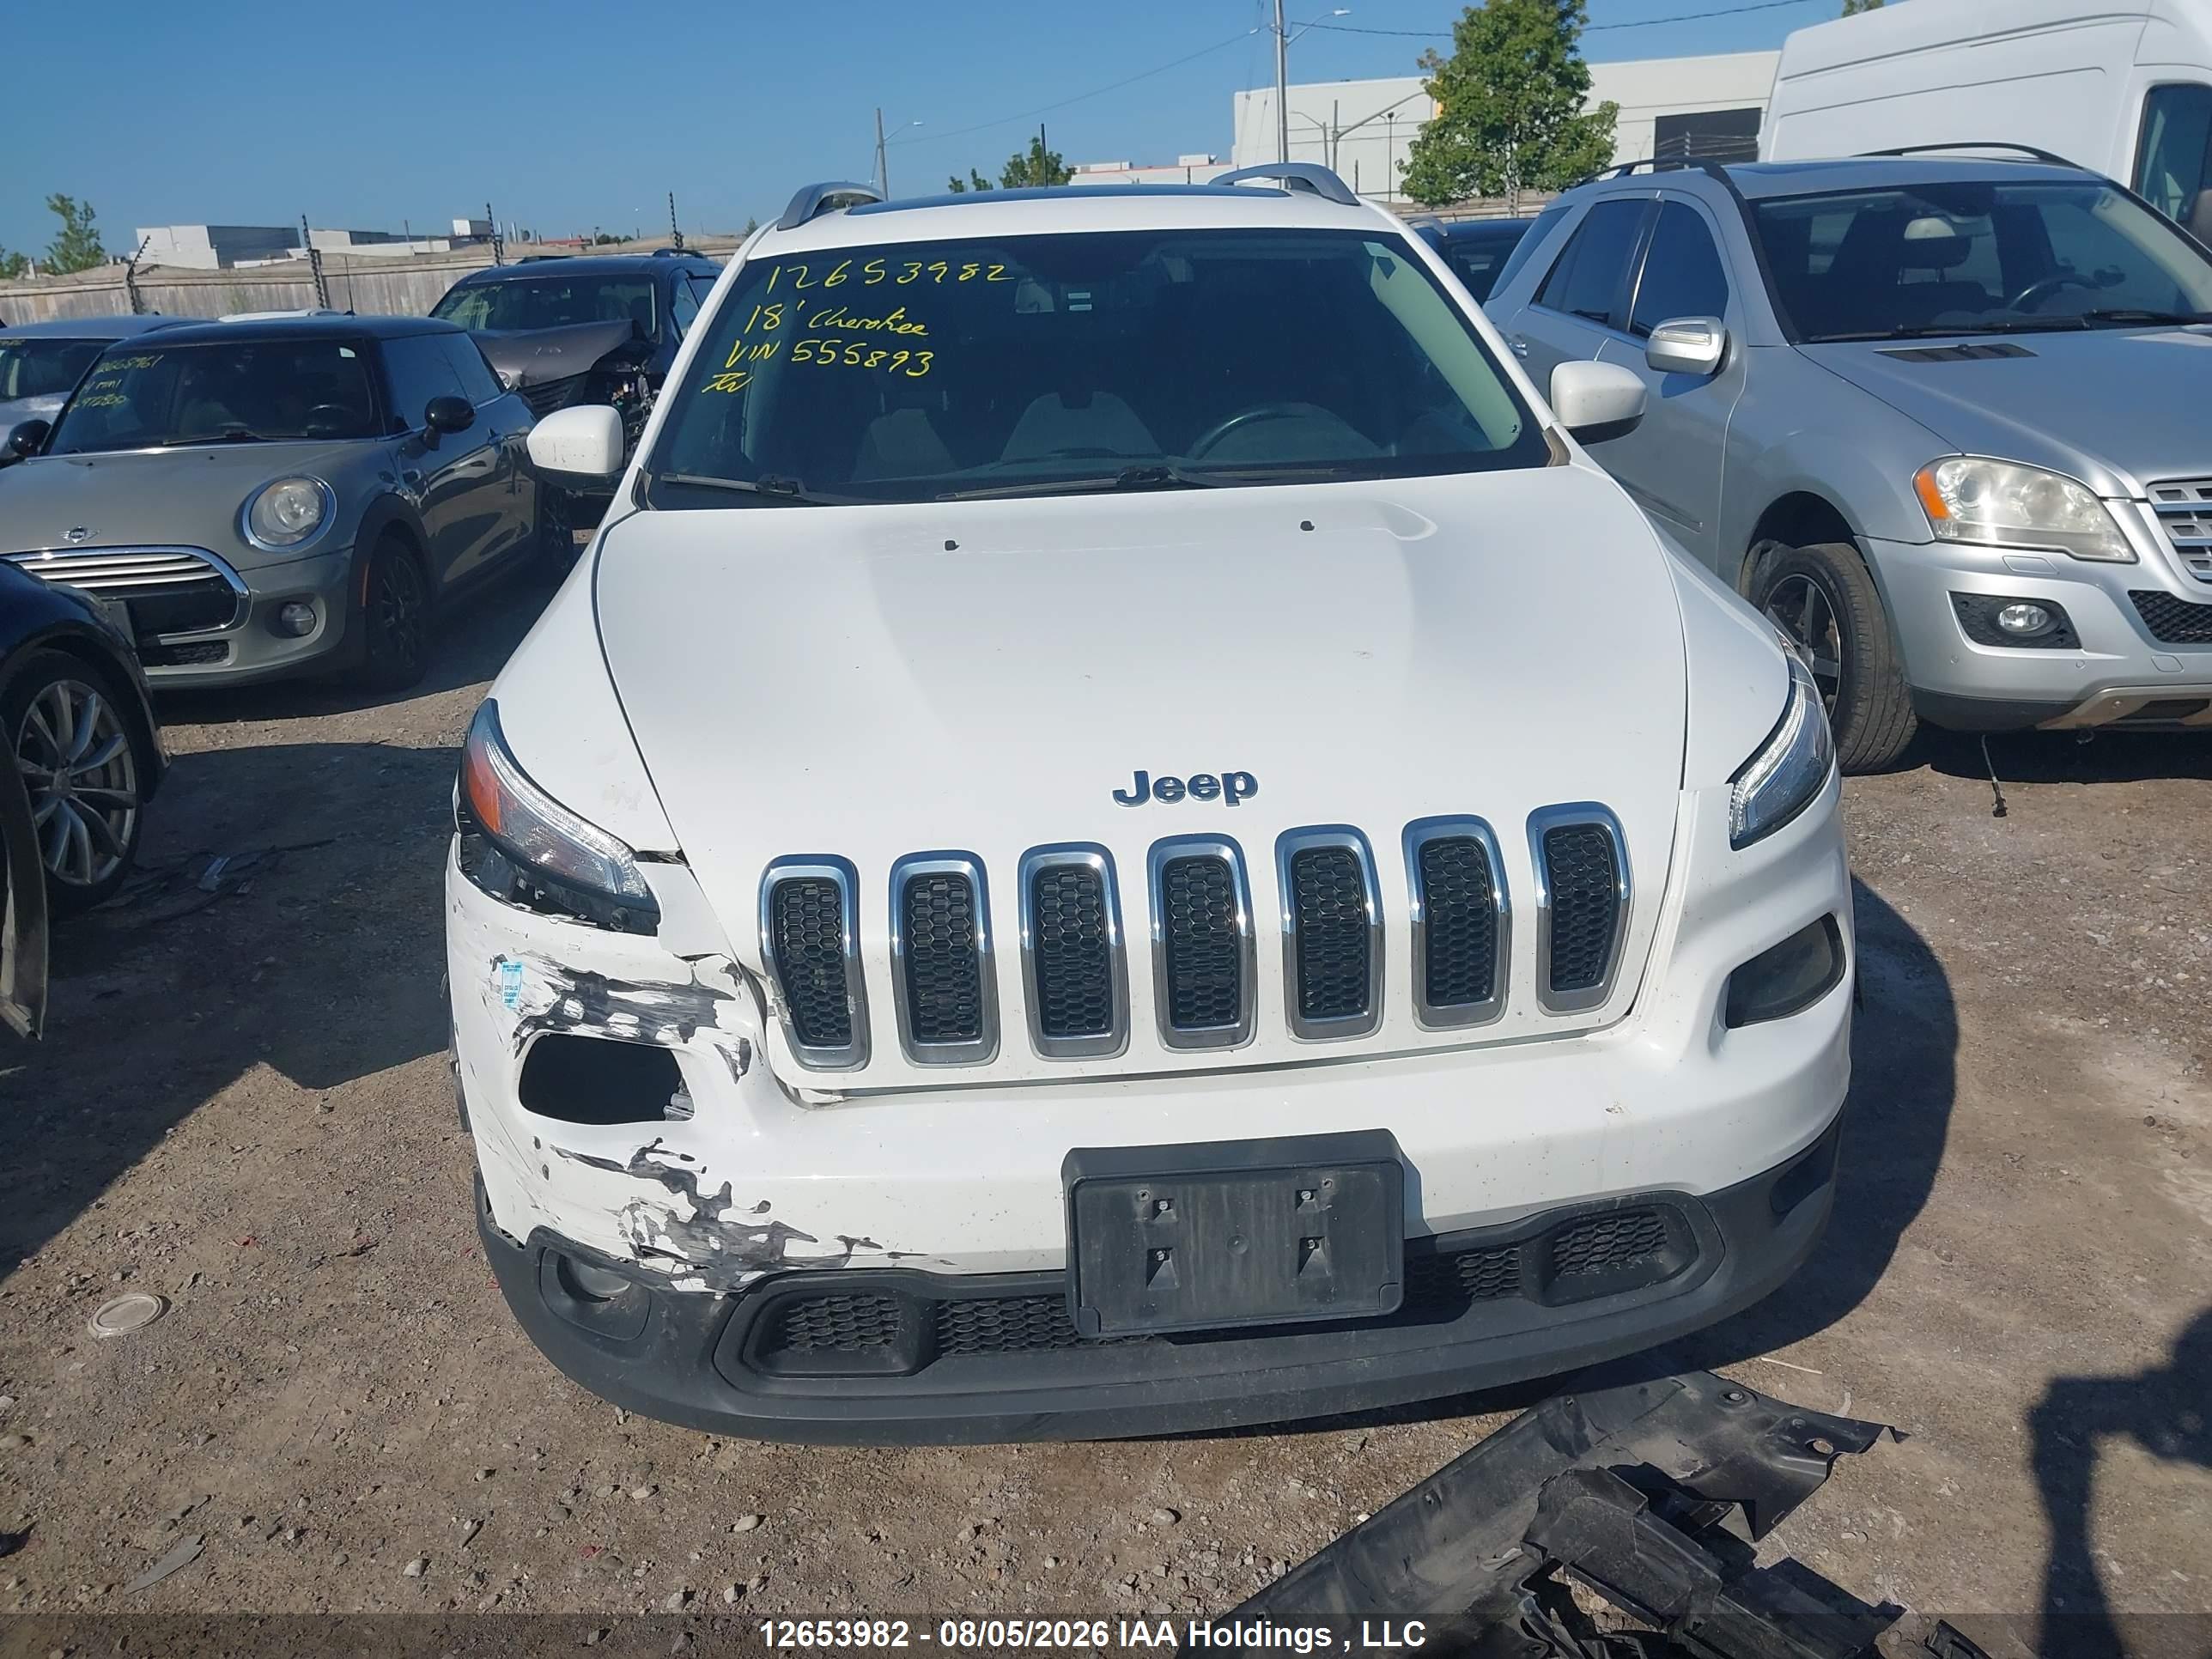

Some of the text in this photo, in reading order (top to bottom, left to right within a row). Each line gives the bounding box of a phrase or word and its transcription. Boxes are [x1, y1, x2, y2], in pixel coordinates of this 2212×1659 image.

[767, 259, 1016, 295] 12653982
[808, 307, 930, 336] Cherokee
[725, 340, 934, 376] VIN 555893
[1112, 770, 1259, 807] Jeep
